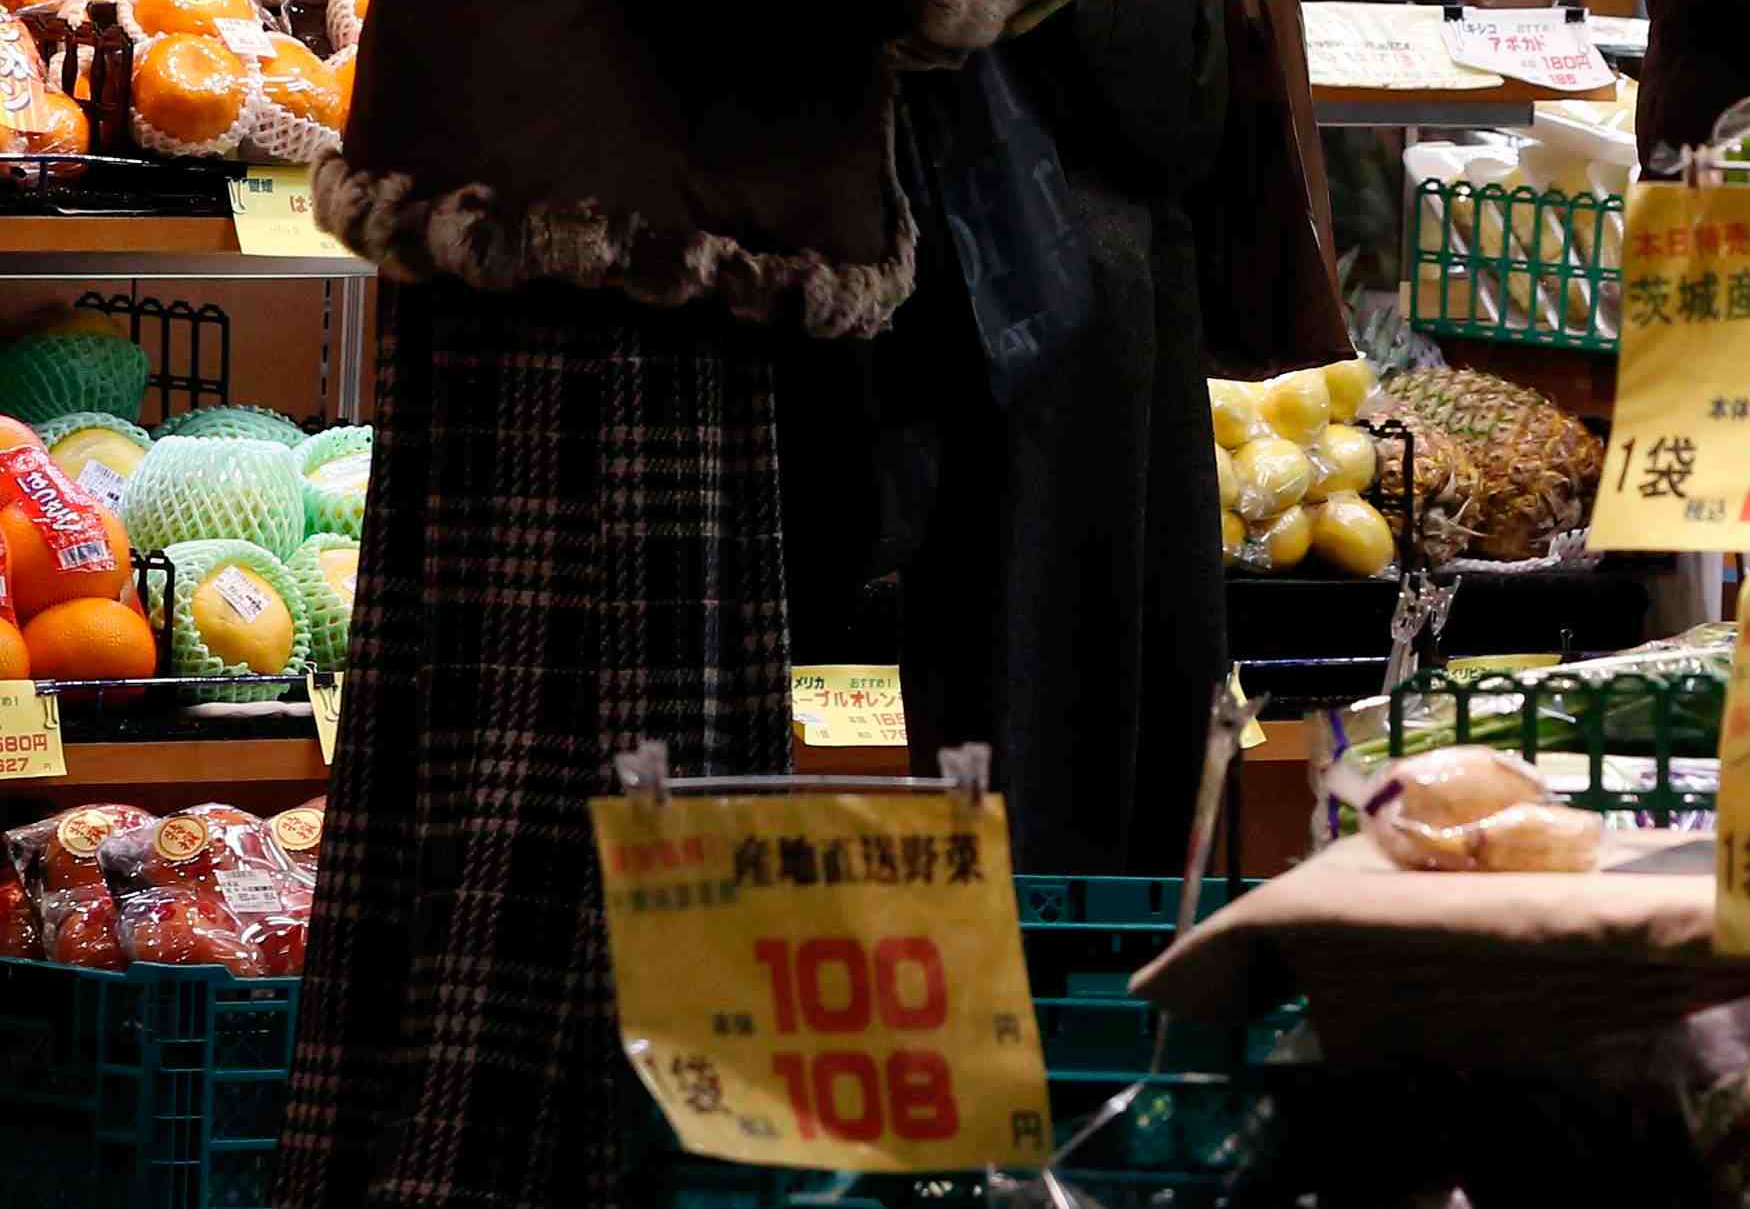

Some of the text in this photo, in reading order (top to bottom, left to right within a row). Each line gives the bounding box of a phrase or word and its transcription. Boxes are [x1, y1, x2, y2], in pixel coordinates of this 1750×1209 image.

[1488, 35, 1545, 53] アボカド
[1616, 436, 1697, 500] 1袋
[733, 832, 985, 886] 産地直送野菜
[753, 935, 949, 1035] 100
[771, 1047, 961, 1141] 108
[1012, 1109, 1044, 1152] 円
